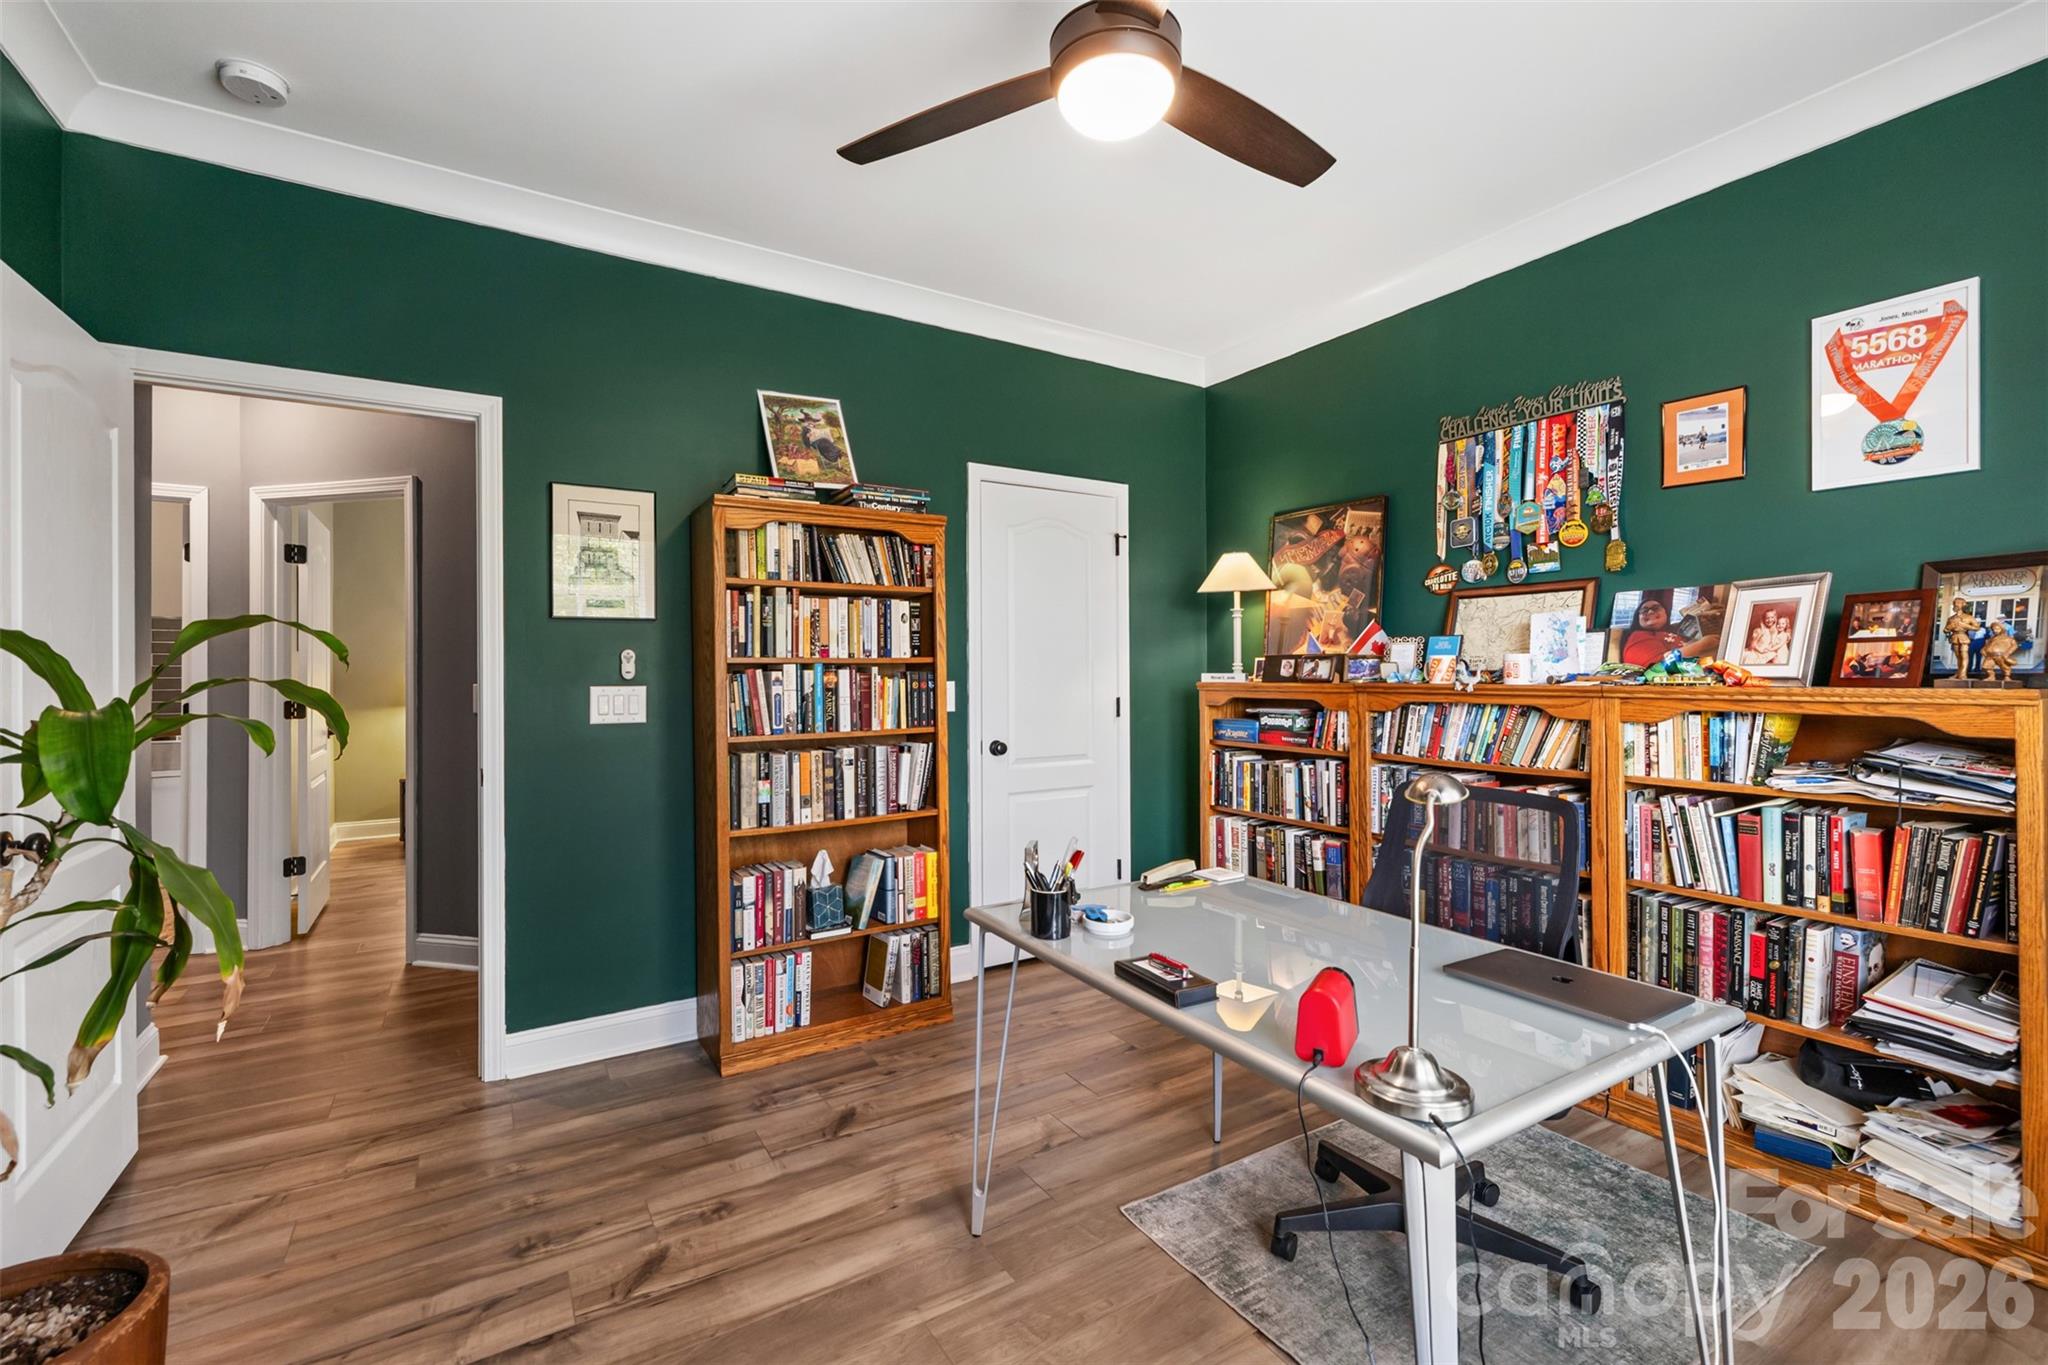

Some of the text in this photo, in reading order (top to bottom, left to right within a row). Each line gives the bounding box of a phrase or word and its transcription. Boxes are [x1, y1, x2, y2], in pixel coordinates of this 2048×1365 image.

[1850, 324, 1928, 359] 5568
[1852, 351, 1923, 371] MARATHON
[1440, 409, 1518, 441] CHALLENGE
[1523, 398, 1563, 422] YOUR
[1570, 384, 1625, 409] LIMITS
[1587, 415, 1597, 466] FINISHER
[1484, 469, 1494, 545] ATC10K FINISHER
[1424, 570, 1459, 586] CHARLOTTE
[825, 690, 833, 721] NARNIA
[1758, 720, 1776, 769] Mayflower
[877, 759, 886, 802] TUROW
[1733, 919, 1742, 966] RENAISSANCE
[1752, 938, 1761, 969] GENIUS
[1769, 972, 1777, 1009] INNOCENT
[1833, 955, 1844, 1010] WALTER ISAACSON
[1840, 957, 1856, 1014] EINSTEIN
